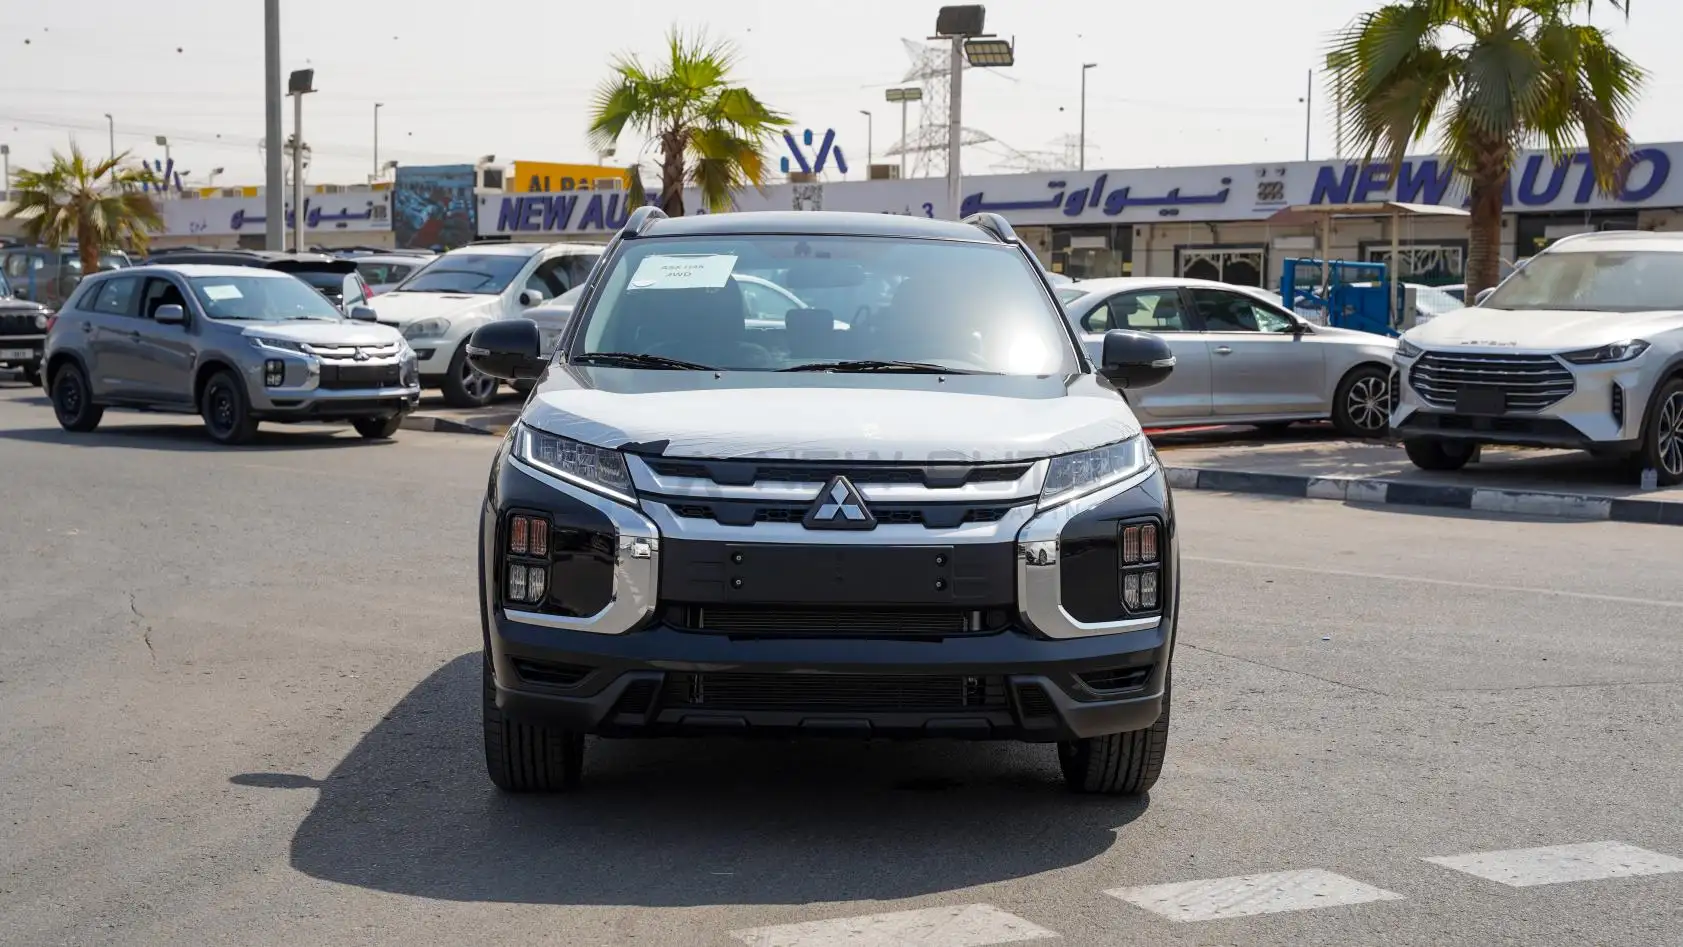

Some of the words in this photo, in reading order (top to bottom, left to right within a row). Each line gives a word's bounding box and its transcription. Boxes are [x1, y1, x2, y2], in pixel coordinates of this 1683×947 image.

[1309, 160, 1454, 206] NEW
[1463, 148, 1671, 206] UTO
[497, 195, 578, 232] NEW
